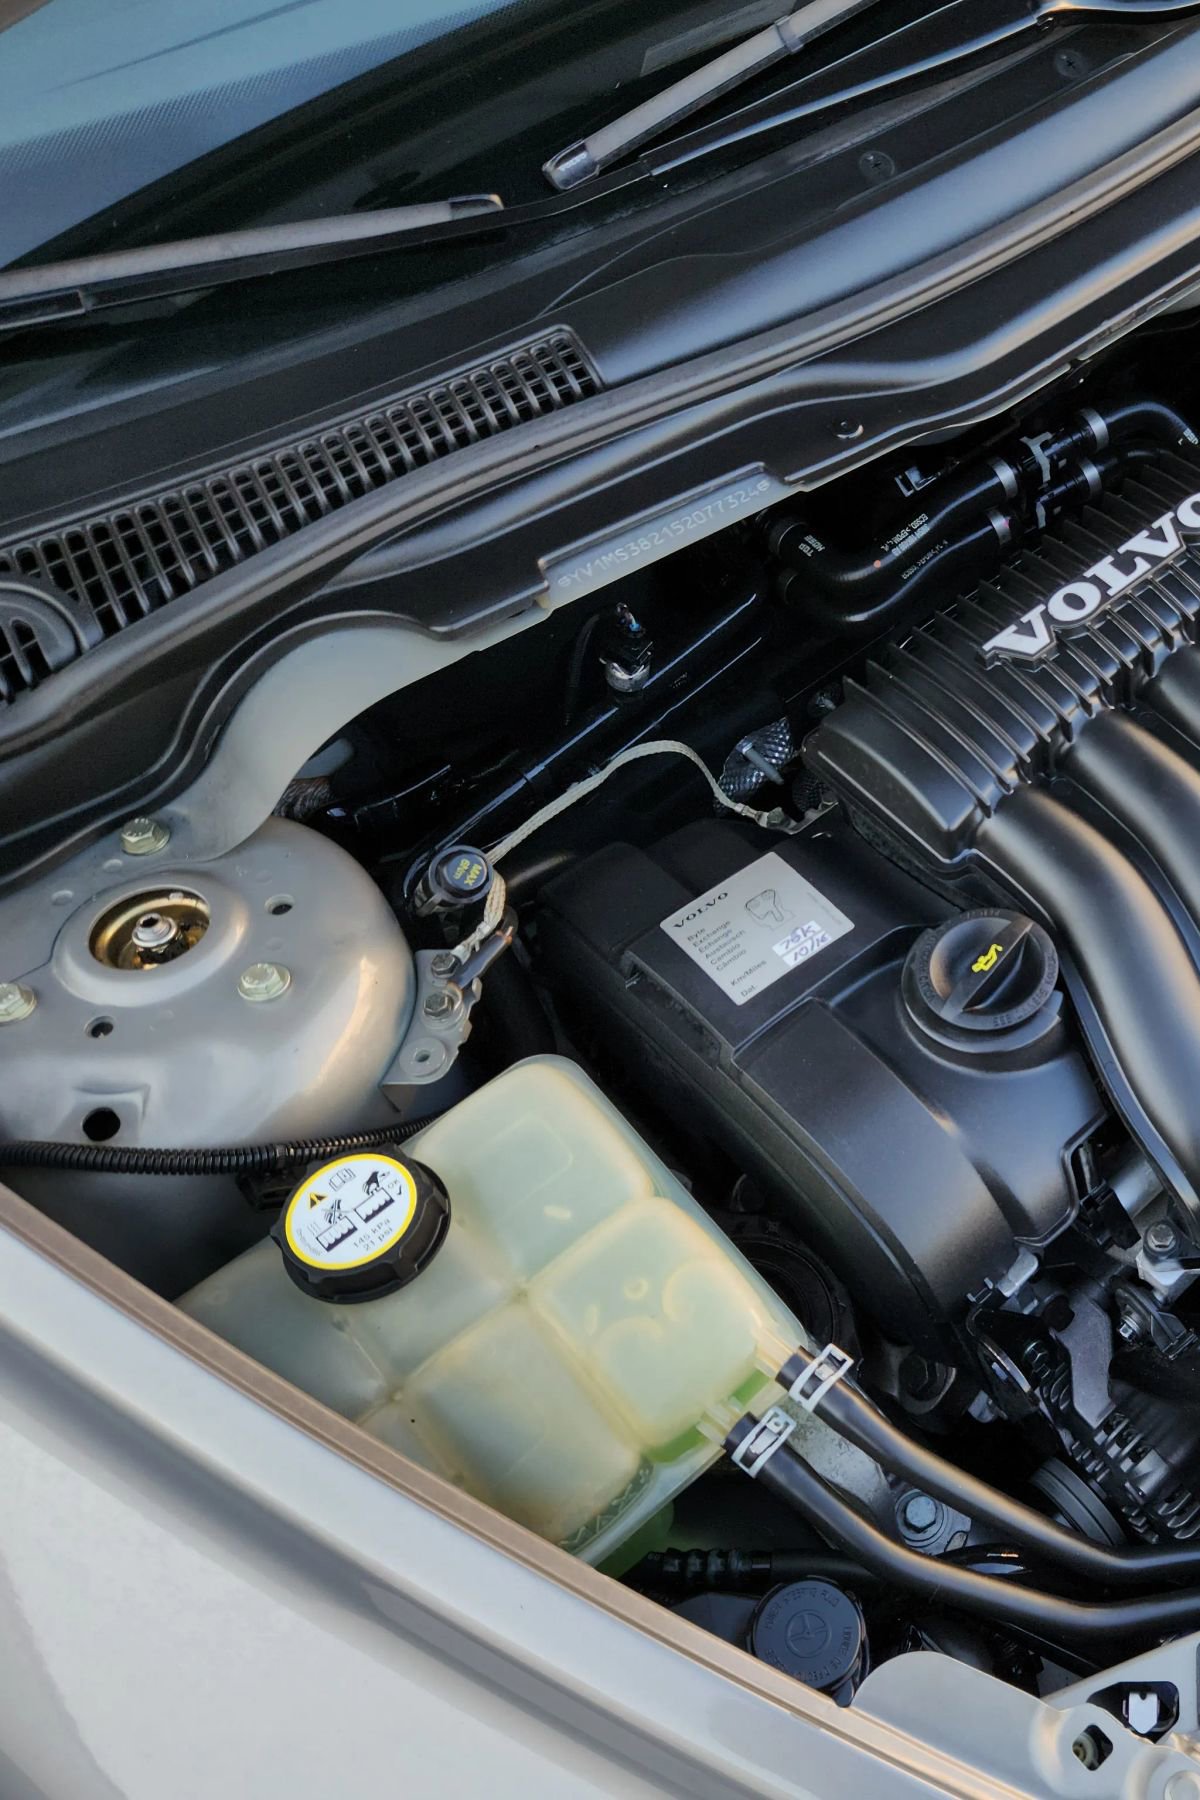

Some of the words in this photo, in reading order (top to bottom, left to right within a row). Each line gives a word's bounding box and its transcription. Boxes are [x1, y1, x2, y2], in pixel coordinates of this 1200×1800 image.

[464, 864, 482, 886] MAX
[673, 892, 728, 928] VOLVO
[687, 927, 706, 941] Byte
[692, 920, 731, 947] Exchange
[704, 930, 746, 959] Austausch
[710, 943, 741, 965] Cambio
[730, 960, 767, 986] Km/Miles
[371, 1218, 391, 1236] kPa
